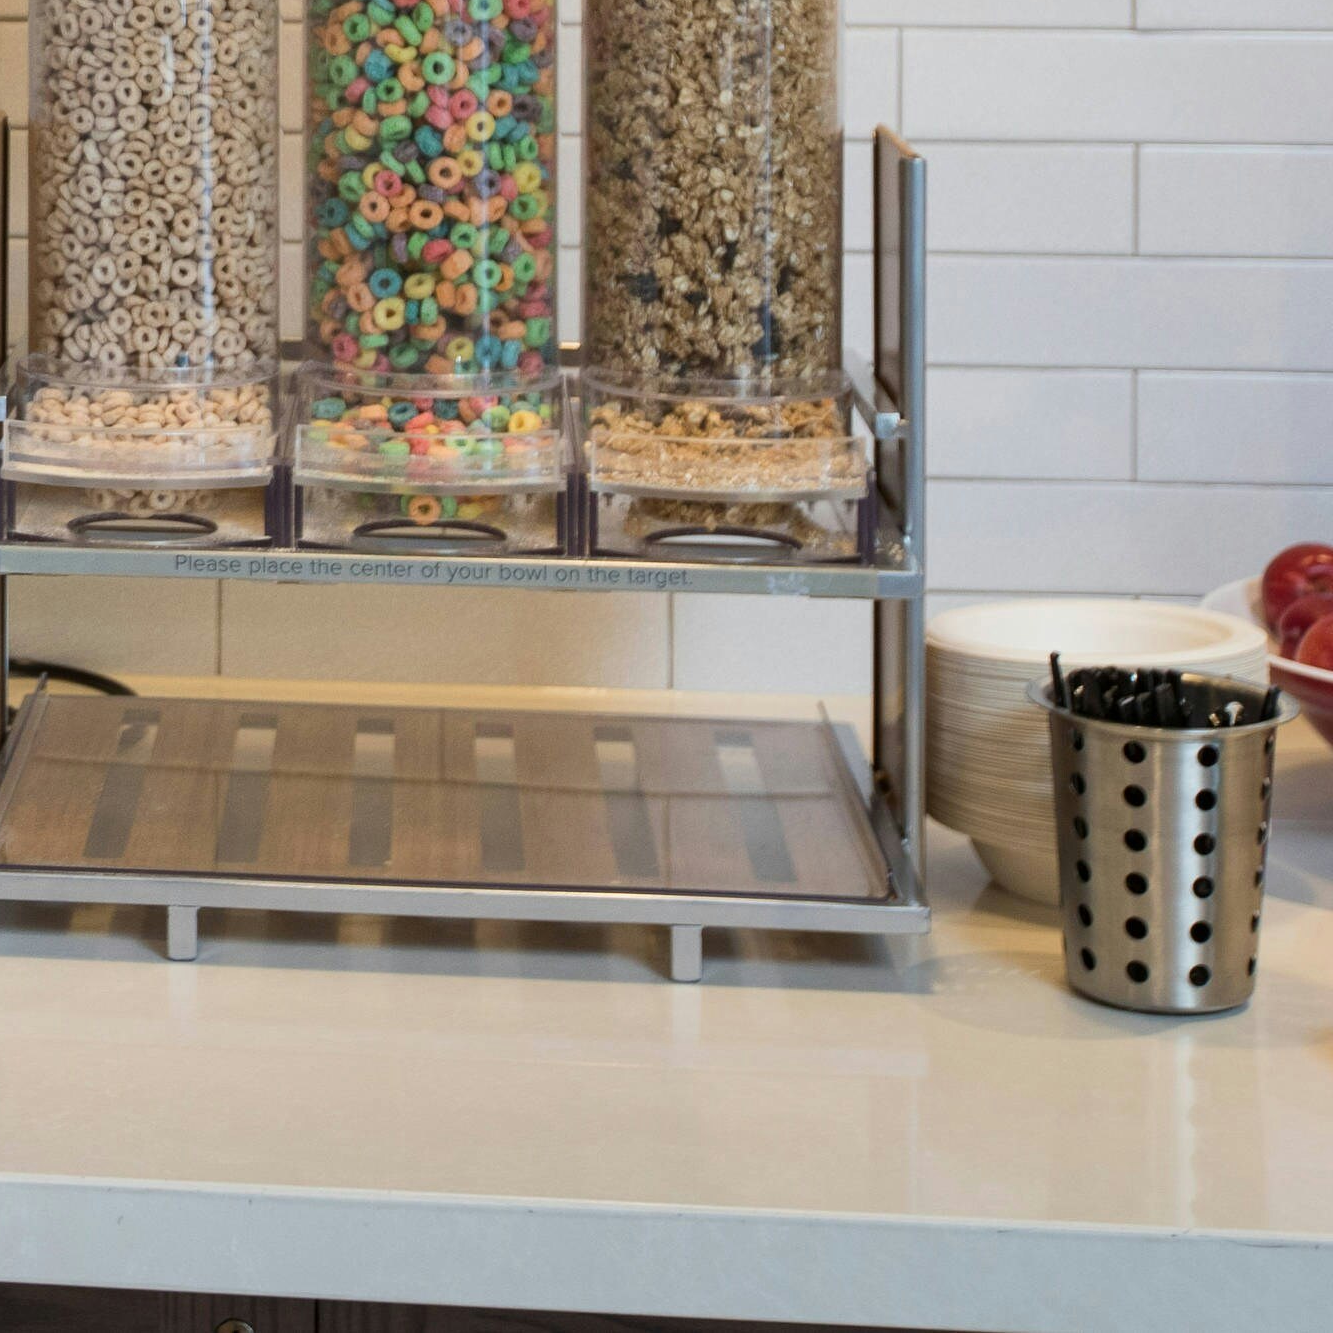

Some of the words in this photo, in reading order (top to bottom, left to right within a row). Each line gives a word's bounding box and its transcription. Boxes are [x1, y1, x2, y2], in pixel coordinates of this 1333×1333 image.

[175, 554, 241, 573] Please
[249, 557, 302, 576] place
[311, 559, 342, 576] the
[349, 560, 413, 577] center
[421, 562, 440, 579] of
[448, 565, 491, 582] your
[499, 566, 548, 581] bowl
[555, 568, 580, 582] on
[589, 567, 620, 583] the
[627, 567, 693, 588] target.
